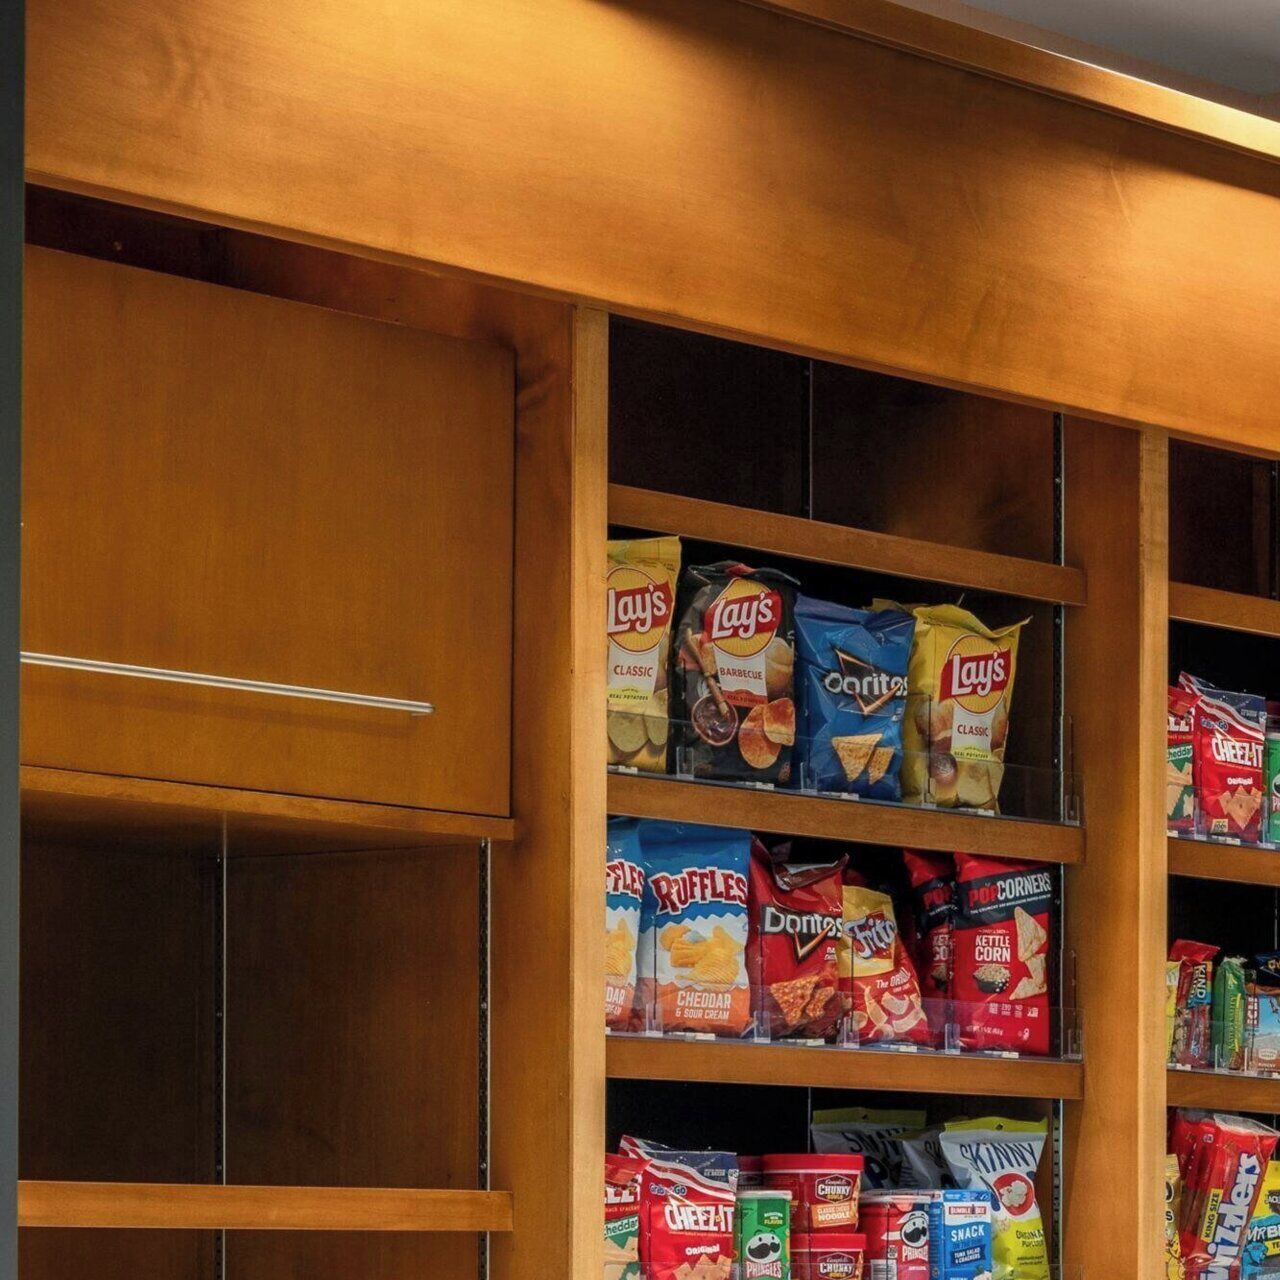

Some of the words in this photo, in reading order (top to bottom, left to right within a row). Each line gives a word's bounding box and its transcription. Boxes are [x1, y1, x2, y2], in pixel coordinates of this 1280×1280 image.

[608, 585, 666, 633] Lay's
[712, 592, 773, 639] Lay's
[614, 665, 653, 677] CLASSIC
[720, 668, 763, 679] BARBECUE
[952, 652, 1005, 696] Lay's
[957, 724, 988, 736] CLASSIC
[649, 868, 748, 915] RUFFLES
[976, 935, 1010, 947] KETTLE
[975, 946, 1010, 962] CORN
[1198, 965, 1206, 999] KIND
[677, 992, 731, 1009] CHEDDAR
[684, 1009, 702, 1018] SOUR
[704, 1010, 729, 1019] CREAM
[818, 1184, 851, 1195] CHUNKY
[1204, 1215, 1215, 1239] KING
[1210, 1192, 1220, 1214] SIZE
[951, 1225, 984, 1242] SNACK
[746, 1261, 782, 1278] PRINGLES
[820, 1263, 853, 1273] CHUNKY
